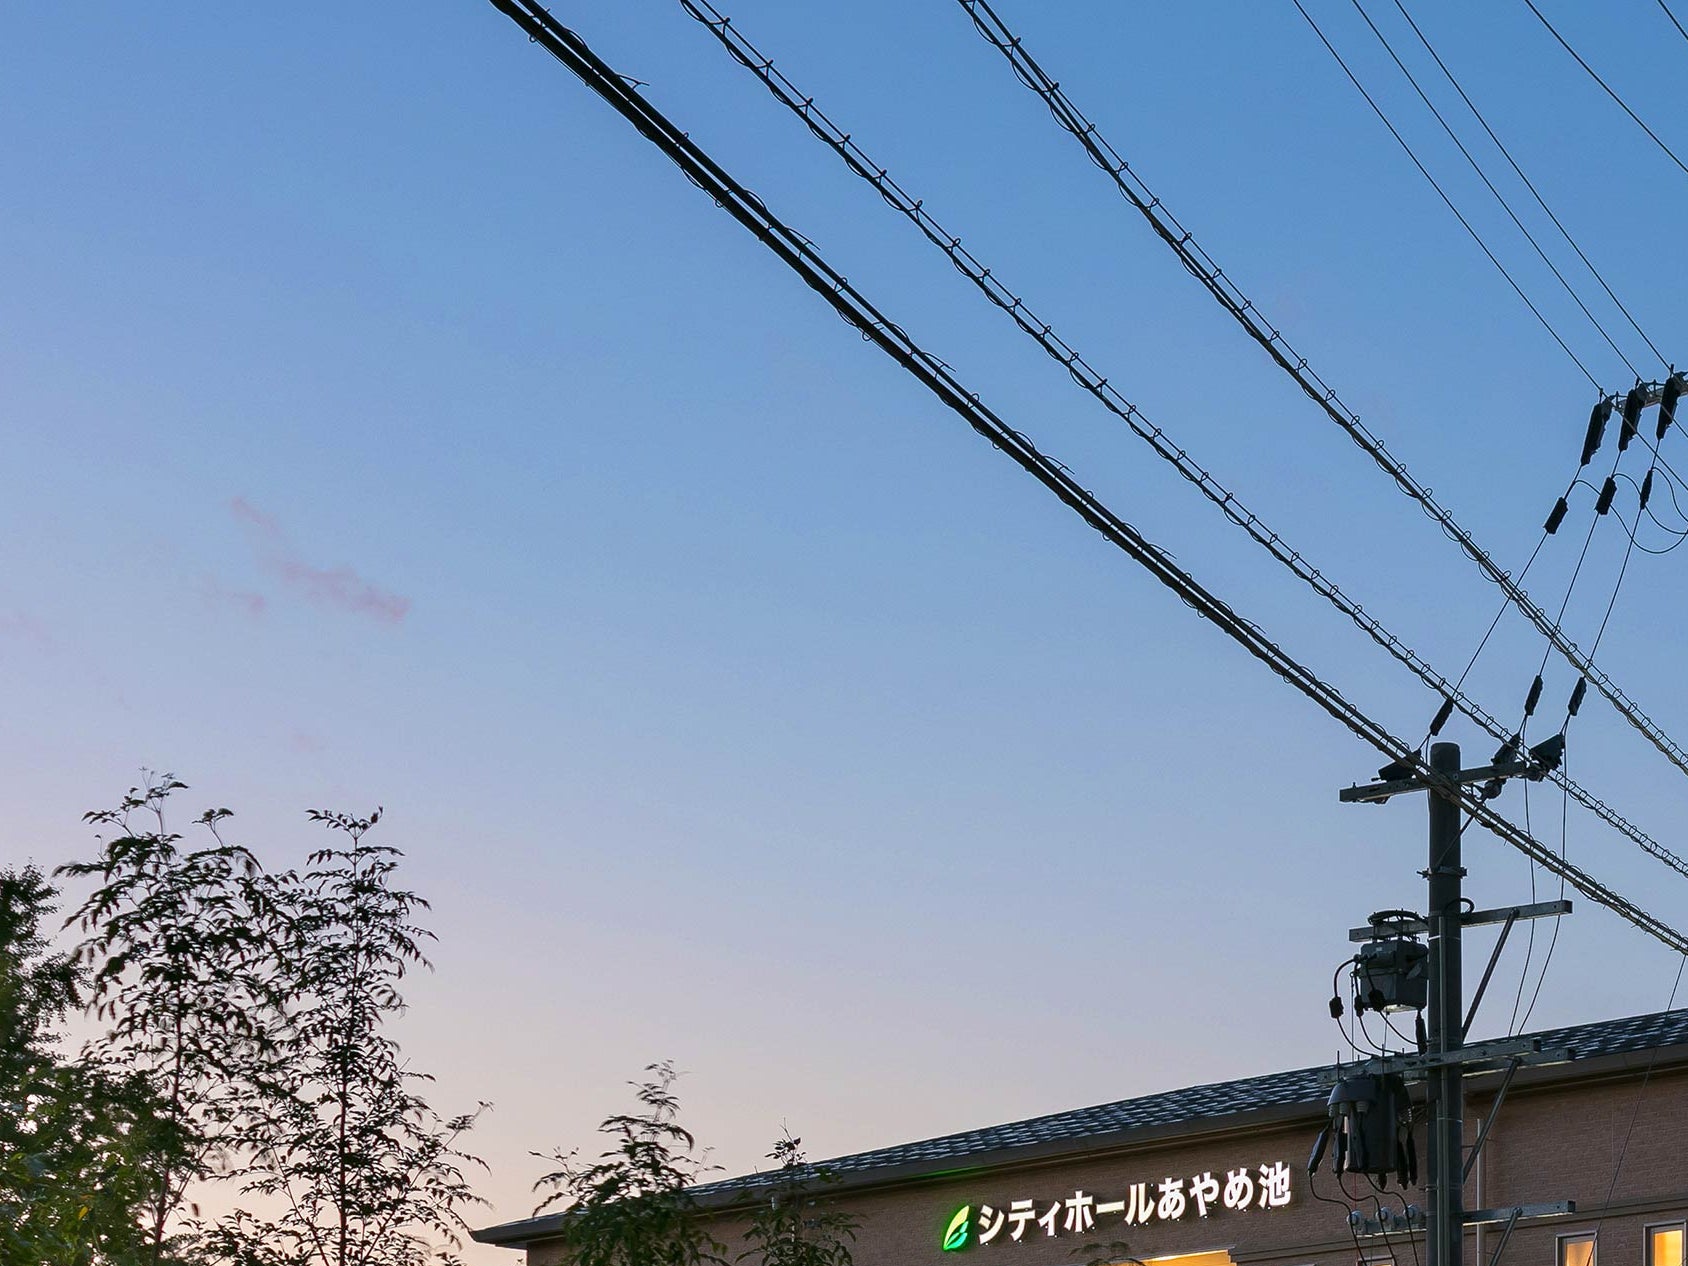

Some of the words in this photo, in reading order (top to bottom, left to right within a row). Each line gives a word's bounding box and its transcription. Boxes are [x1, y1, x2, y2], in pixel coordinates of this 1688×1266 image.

[978, 1162, 1292, 1245] シティホールあやめ池
